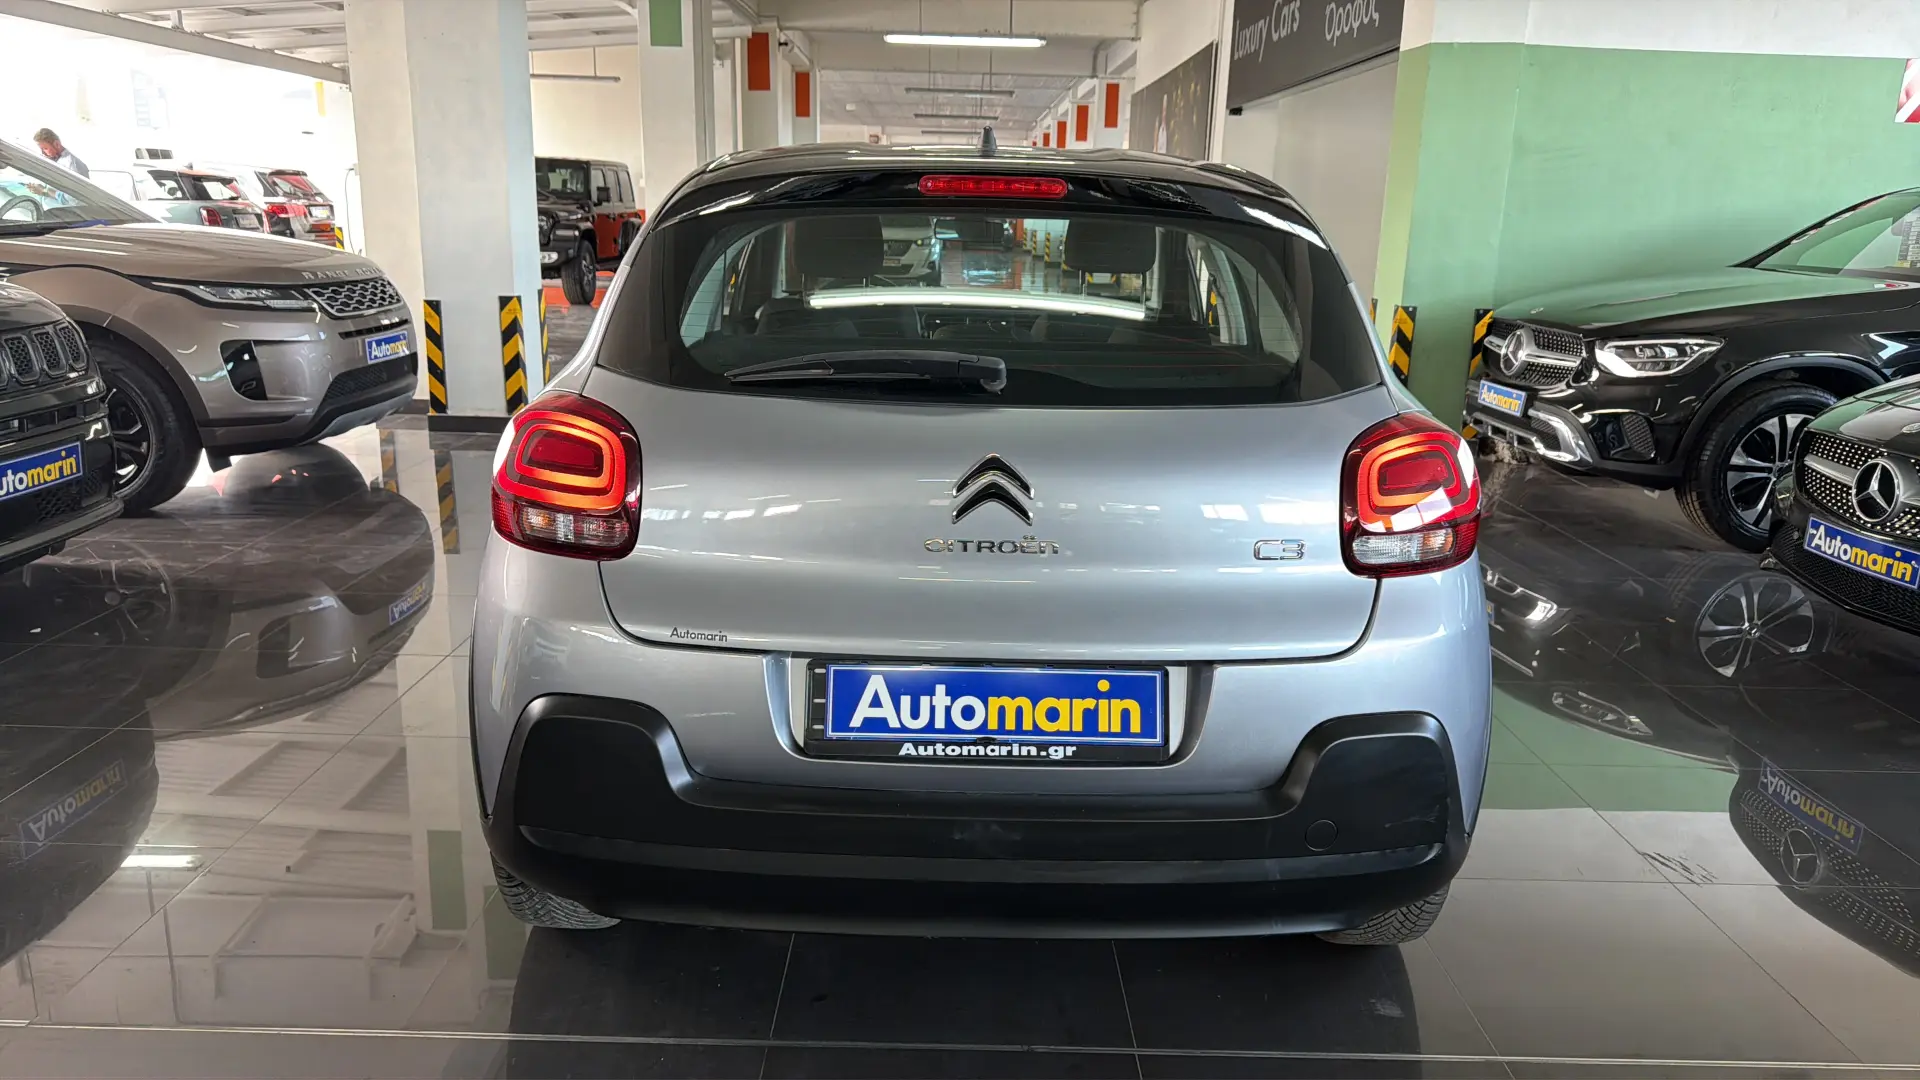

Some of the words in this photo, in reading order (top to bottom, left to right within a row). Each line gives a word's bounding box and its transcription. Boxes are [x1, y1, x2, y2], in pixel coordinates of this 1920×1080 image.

[1234, 16, 1269, 62] Luxury
[1271, 0, 1301, 42] Cars
[0, 450, 77, 496] utomarin
[1253, 539, 1304, 561] C3
[1811, 524, 1913, 582] Automarin
[669, 626, 728, 643] Automarin
[848, 674, 1142, 734] Automarin
[898, 742, 1077, 760] Automarin.gr
